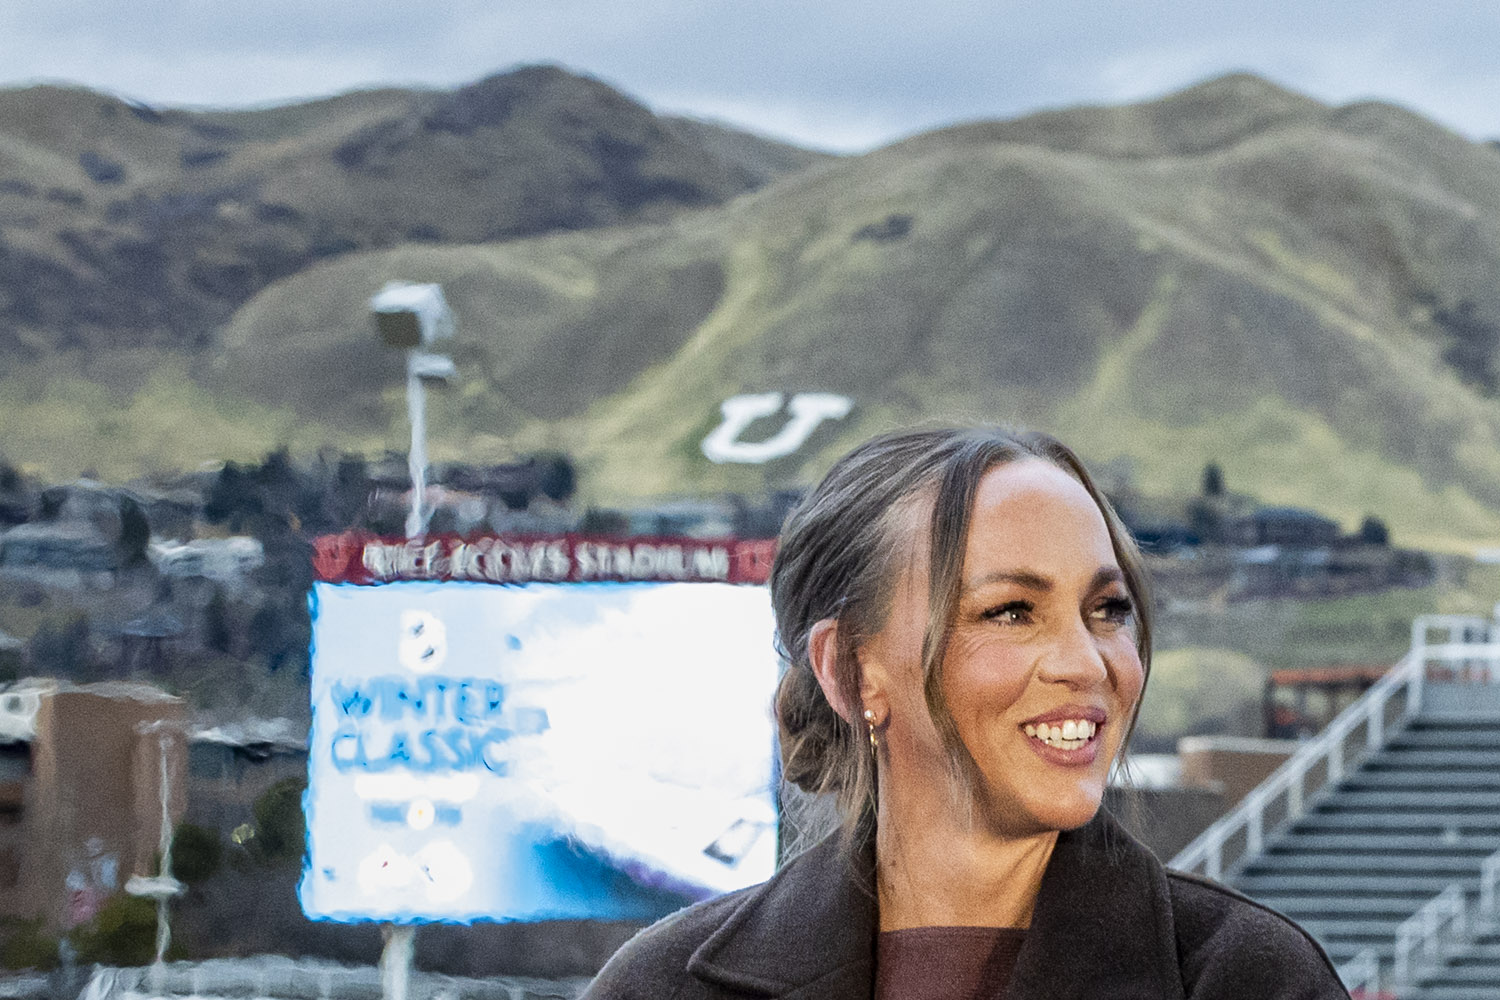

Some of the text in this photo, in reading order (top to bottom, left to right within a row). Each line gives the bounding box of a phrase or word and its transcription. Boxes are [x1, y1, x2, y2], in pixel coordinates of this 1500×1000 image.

[703, 392, 855, 464] U
[331, 676, 506, 722] WINTER
[331, 728, 514, 778] CLASSIC
